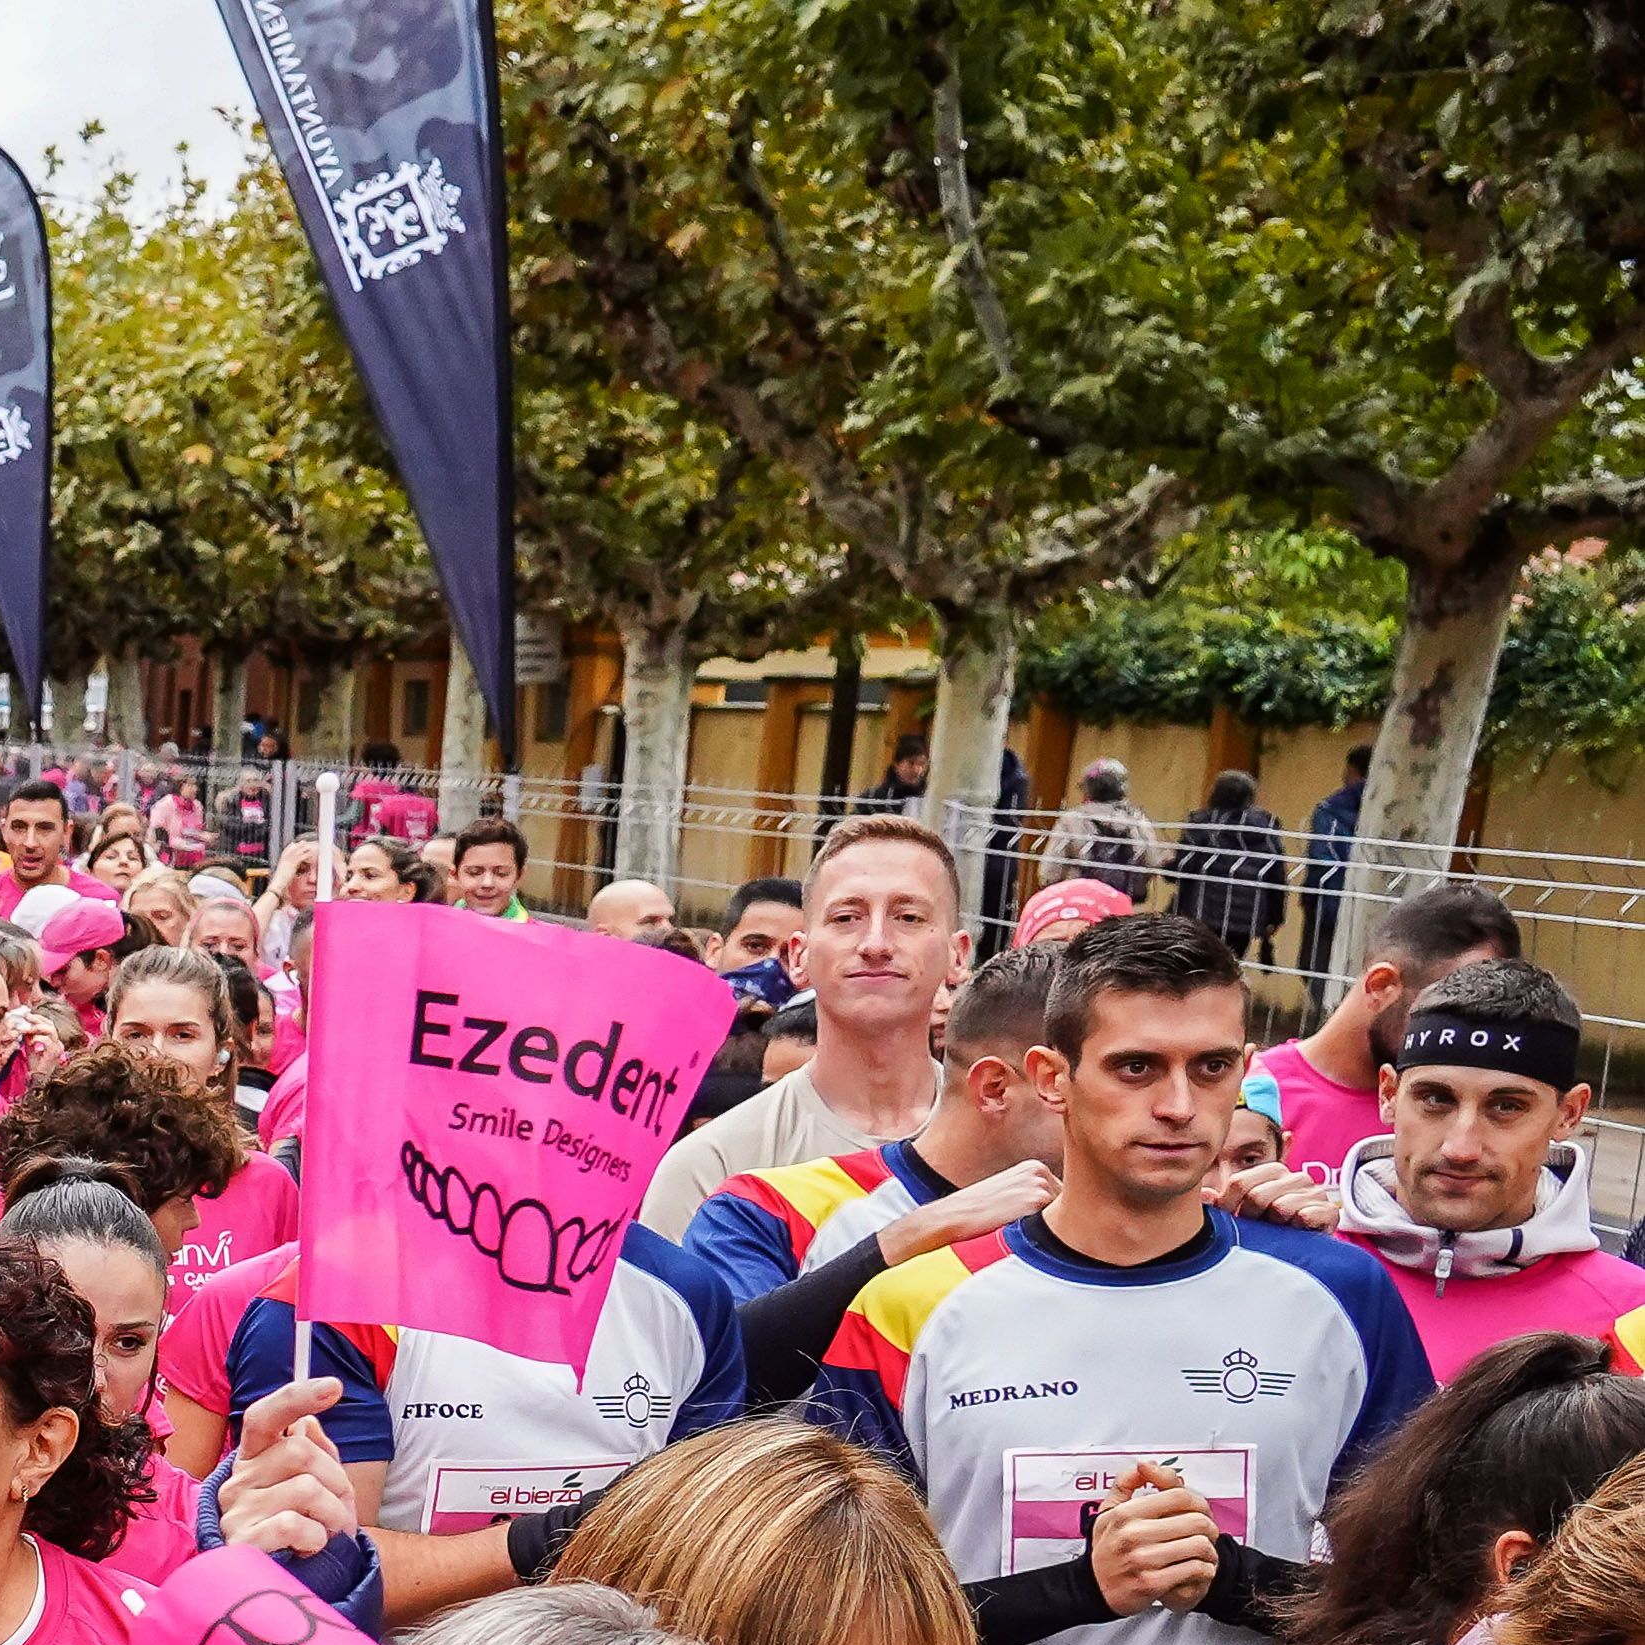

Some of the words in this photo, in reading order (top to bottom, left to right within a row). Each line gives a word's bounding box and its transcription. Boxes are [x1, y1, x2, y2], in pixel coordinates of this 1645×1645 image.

[410, 989, 679, 1137] Ezedent
[448, 1102, 534, 1141] Smile
[542, 1118, 632, 1182] Designers
[950, 1380, 1078, 1410] MEDRANO
[401, 1403, 484, 1419] FIFOCE
[490, 1487, 511, 1504] el
[516, 1486, 584, 1504] bierzo
